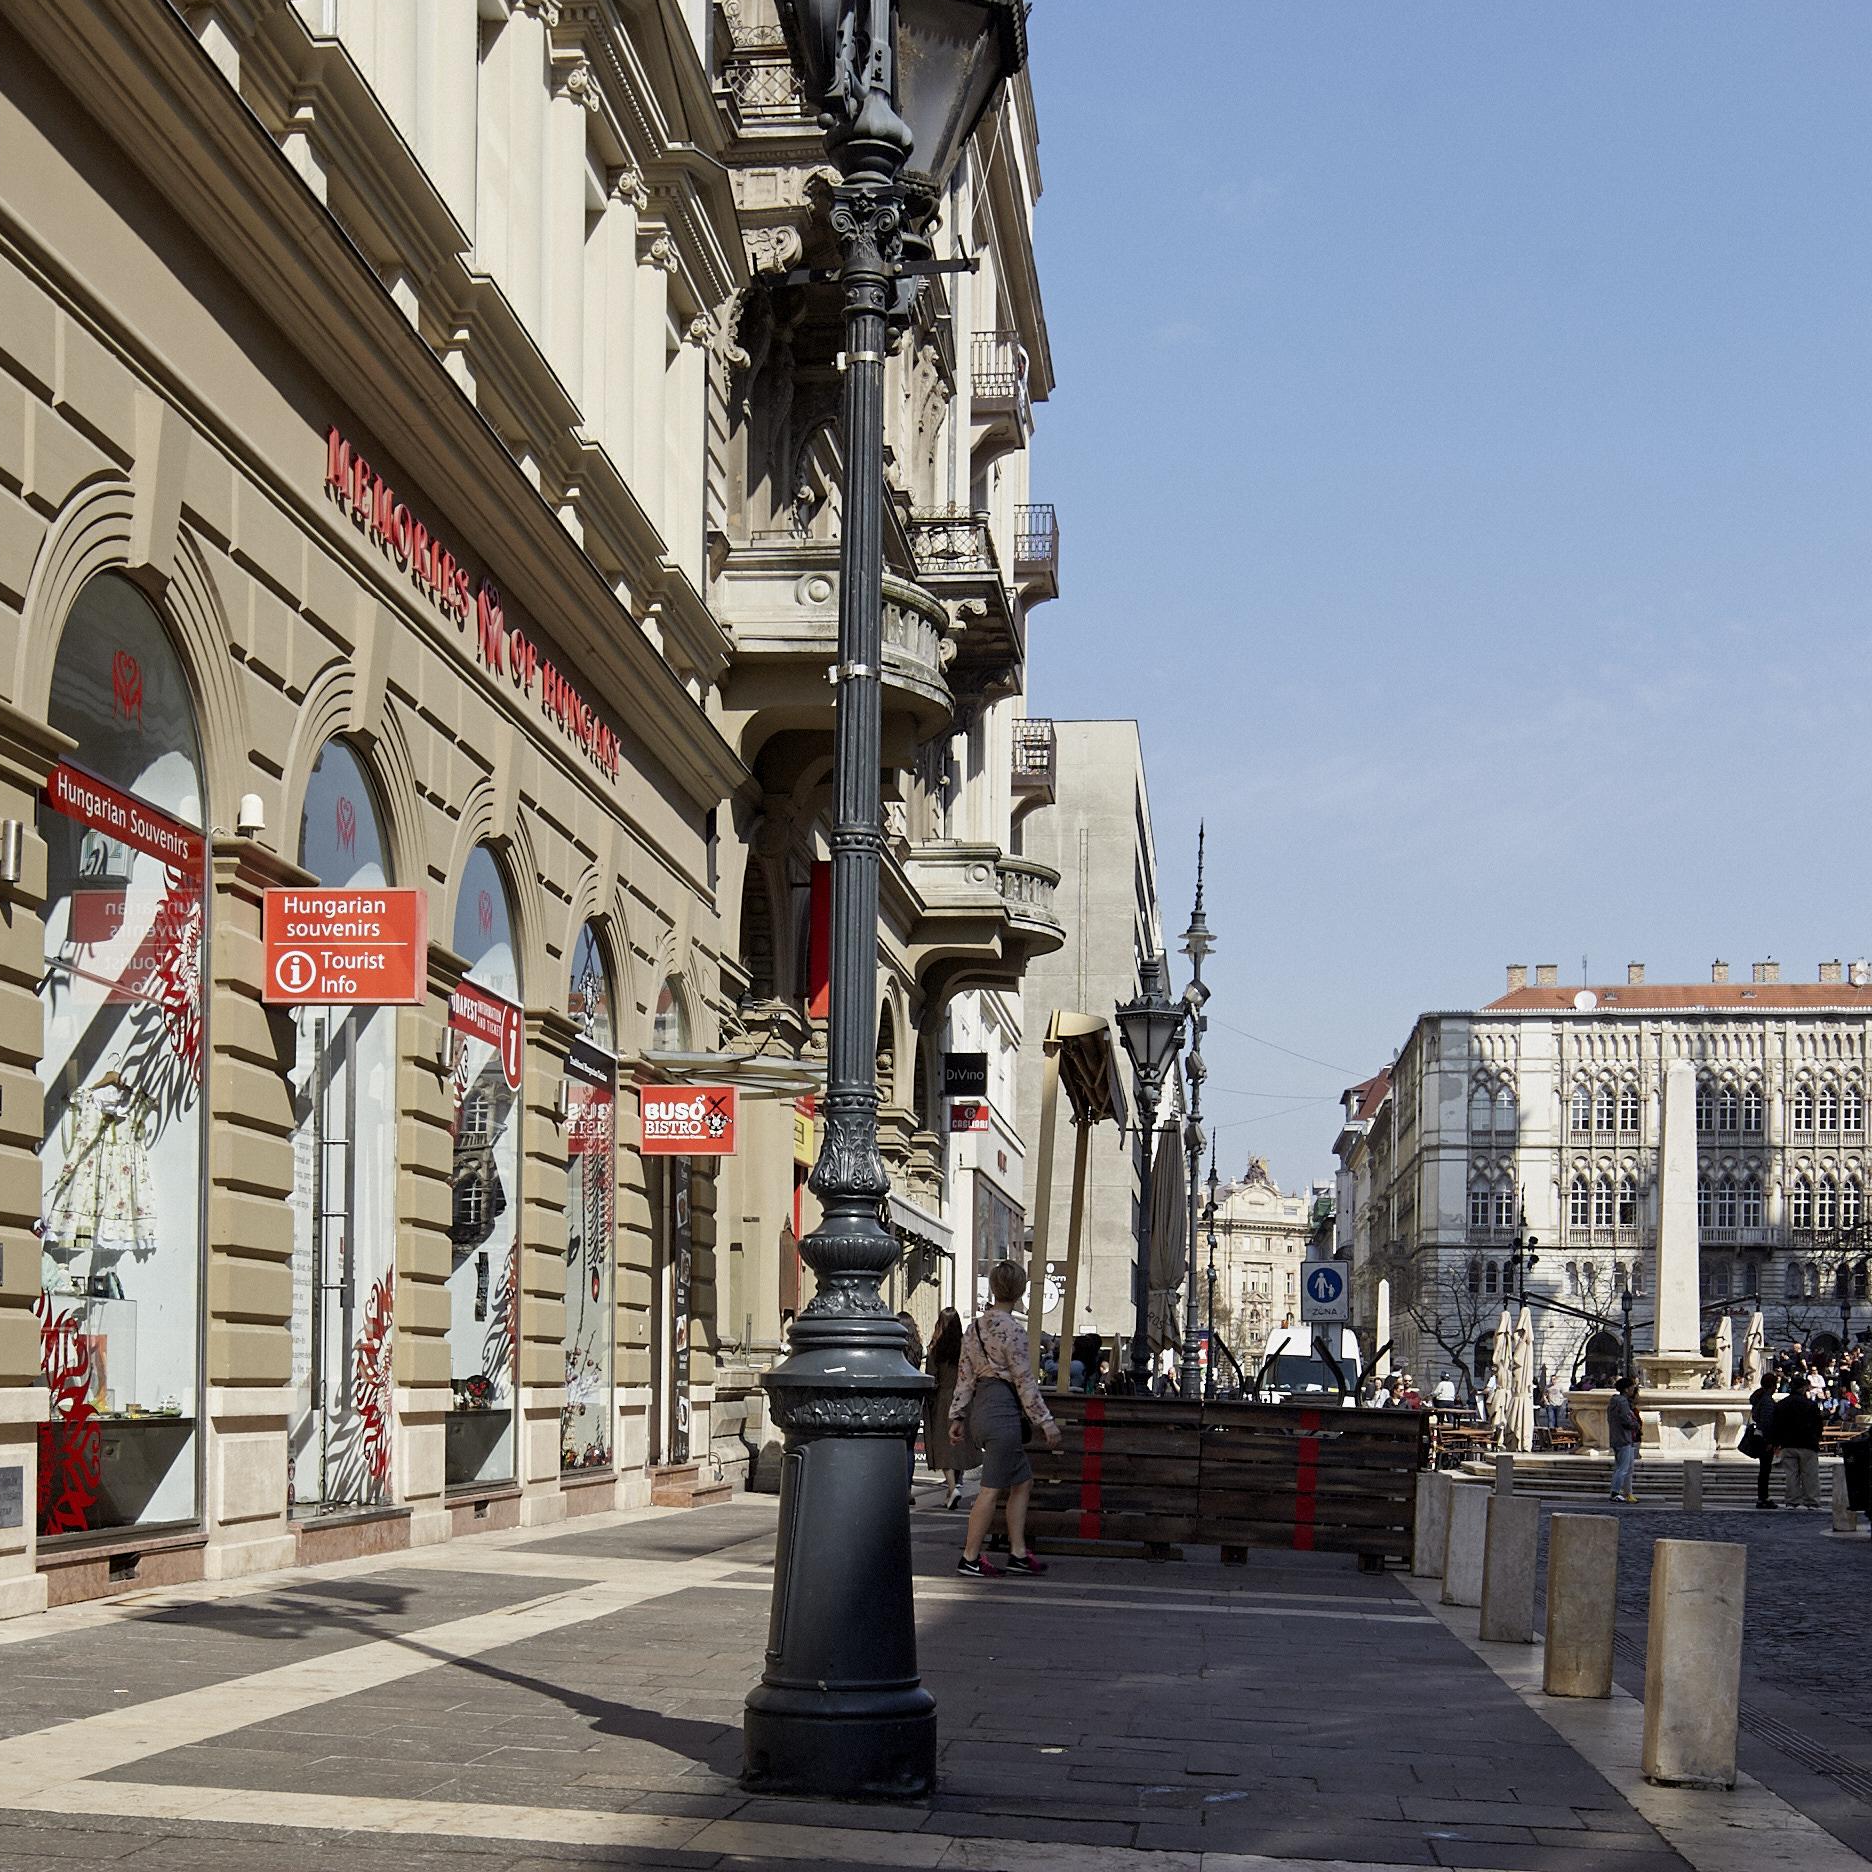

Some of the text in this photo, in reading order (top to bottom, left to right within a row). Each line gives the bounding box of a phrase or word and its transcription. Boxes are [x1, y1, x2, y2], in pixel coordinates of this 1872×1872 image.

[325, 425, 623, 777] MEMORIES OF HUNGARY
[57, 771, 189, 861] Hungarian Souvenirs
[284, 895, 386, 919] Hungarian
[286, 919, 381, 937] souvenirs
[321, 951, 385, 970] Tourist
[321, 975, 357, 994] Info
[449, 992, 478, 1023] UDAPEST
[644, 1120, 701, 1135] BISTRO
